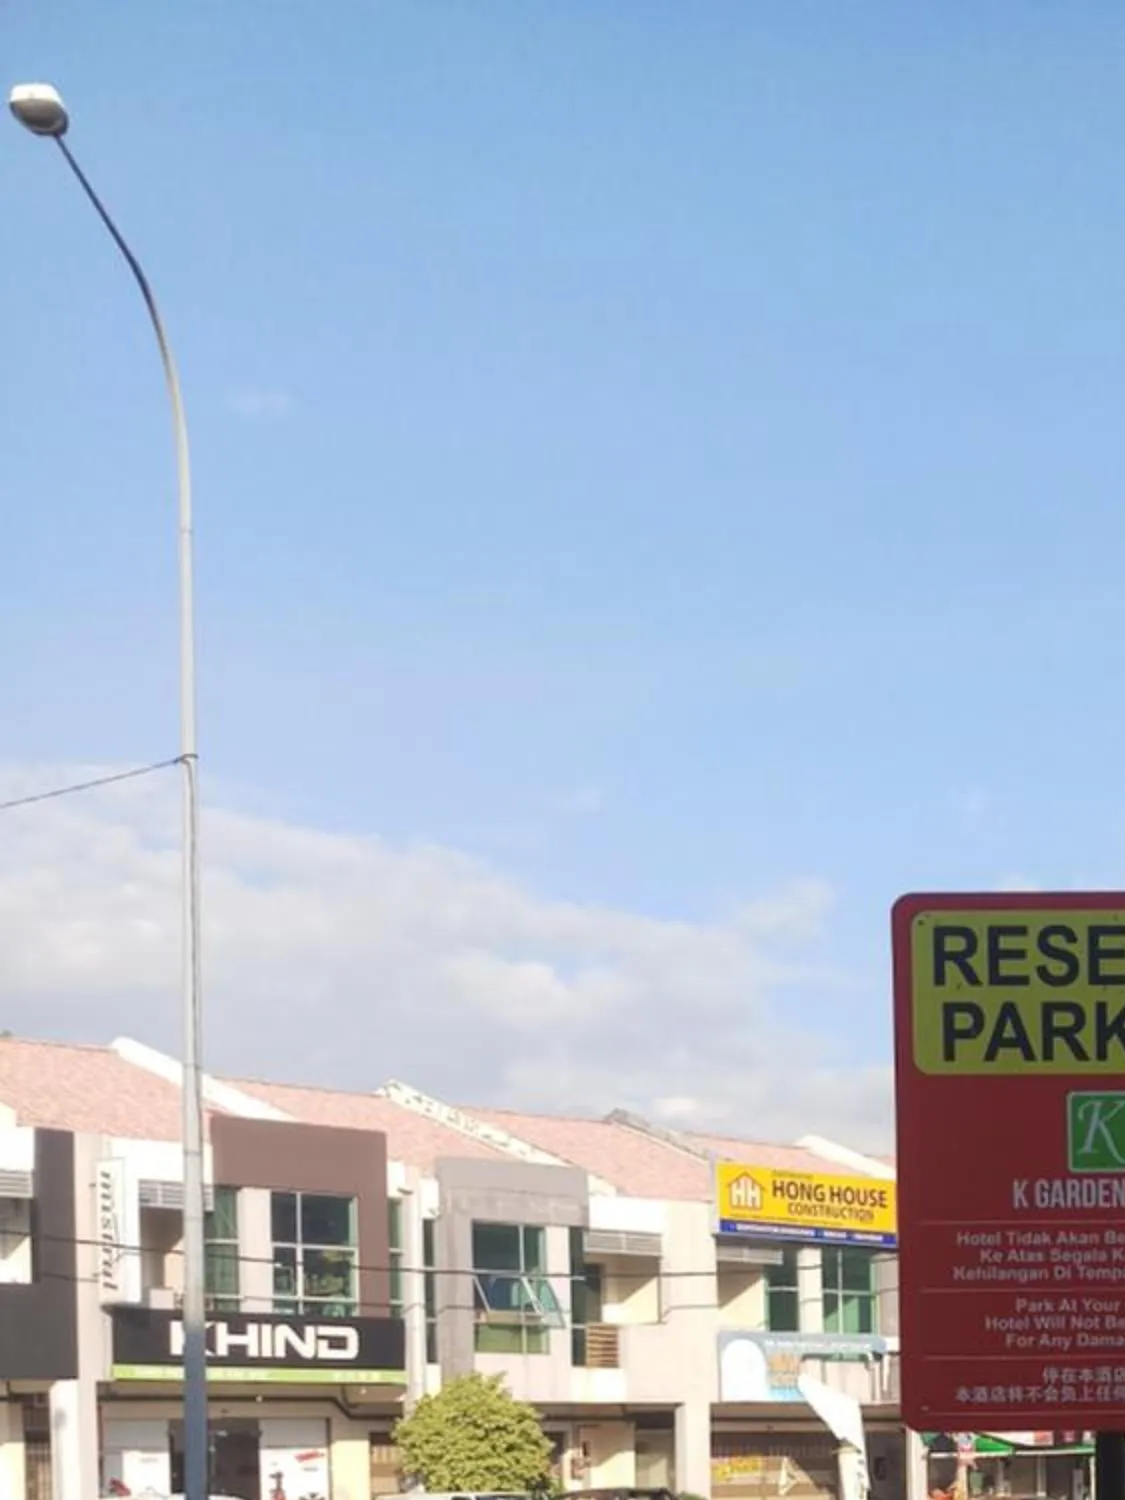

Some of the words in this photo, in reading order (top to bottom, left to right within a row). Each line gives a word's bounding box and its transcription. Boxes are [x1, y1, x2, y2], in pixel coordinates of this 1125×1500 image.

[772, 1179, 825, 1203] HONG
[829, 1186, 889, 1209] HOUSE
[1012, 1178, 1028, 1209] K
[787, 1202, 876, 1223] CONSTRUCTION
[956, 1231, 1002, 1246] Hotel
[1006, 1231, 1051, 1246] Tidak
[1056, 1231, 1100, 1246] Akan
[979, 1248, 1003, 1264] Ke
[1007, 1248, 1046, 1263] Atas
[1050, 1248, 1108, 1266] Segala
[952, 1265, 1049, 1283] Kehilangan
[1053, 1265, 1073, 1281] Di
[1015, 1297, 1054, 1313] Park
[1058, 1297, 1078, 1312] At
[1082, 1298, 1120, 1312] Your
[985, 1314, 1030, 1331] Hotel
[1033, 1314, 1066, 1330] Will
[1070, 1315, 1100, 1330] Not
[169, 1321, 359, 1360] KHIND
[1005, 1332, 1035, 1348] For
[1039, 1332, 1072, 1351] Any
